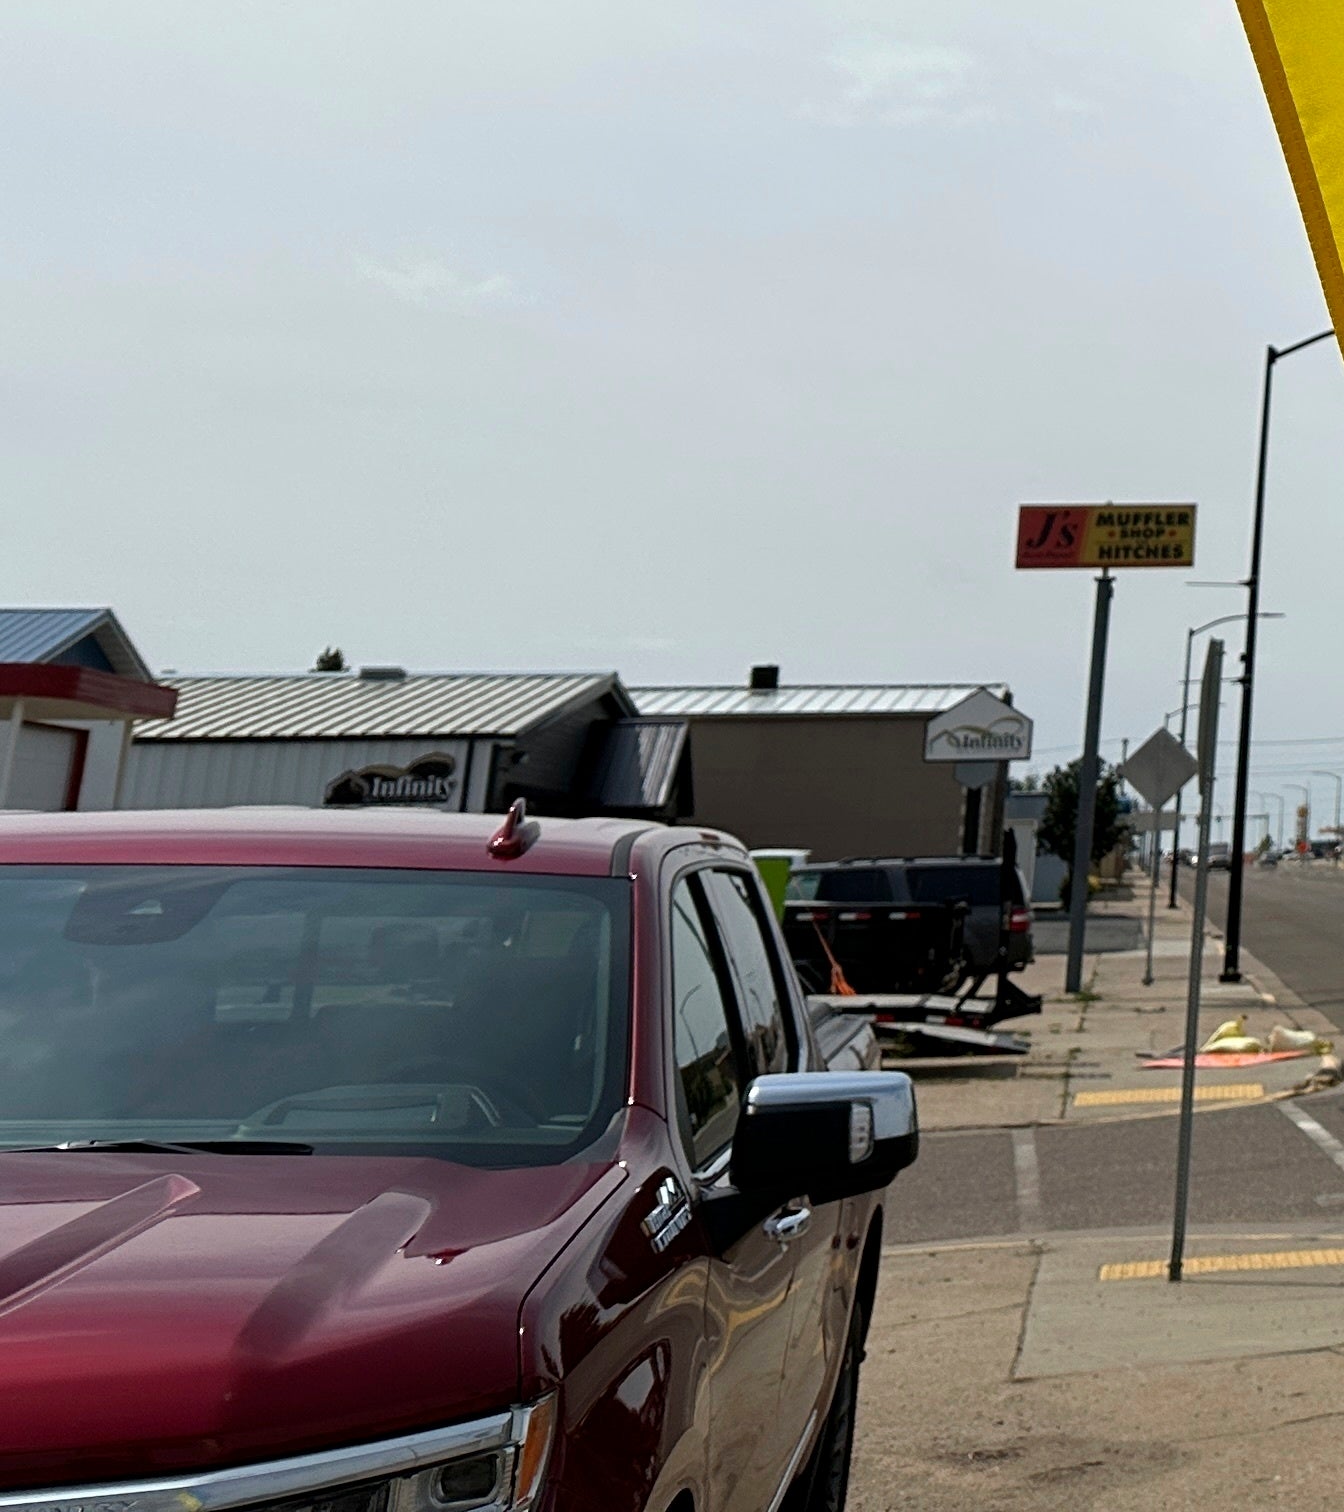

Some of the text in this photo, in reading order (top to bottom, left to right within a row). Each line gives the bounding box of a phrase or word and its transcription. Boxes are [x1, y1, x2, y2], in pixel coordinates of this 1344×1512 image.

[1096, 512, 1189, 527] MUFFLER
[1026, 510, 1078, 548] J's
[1120, 527, 1166, 539] SHOP
[1098, 544, 1184, 559] HITCHES
[373, 775, 455, 797] Infinity
